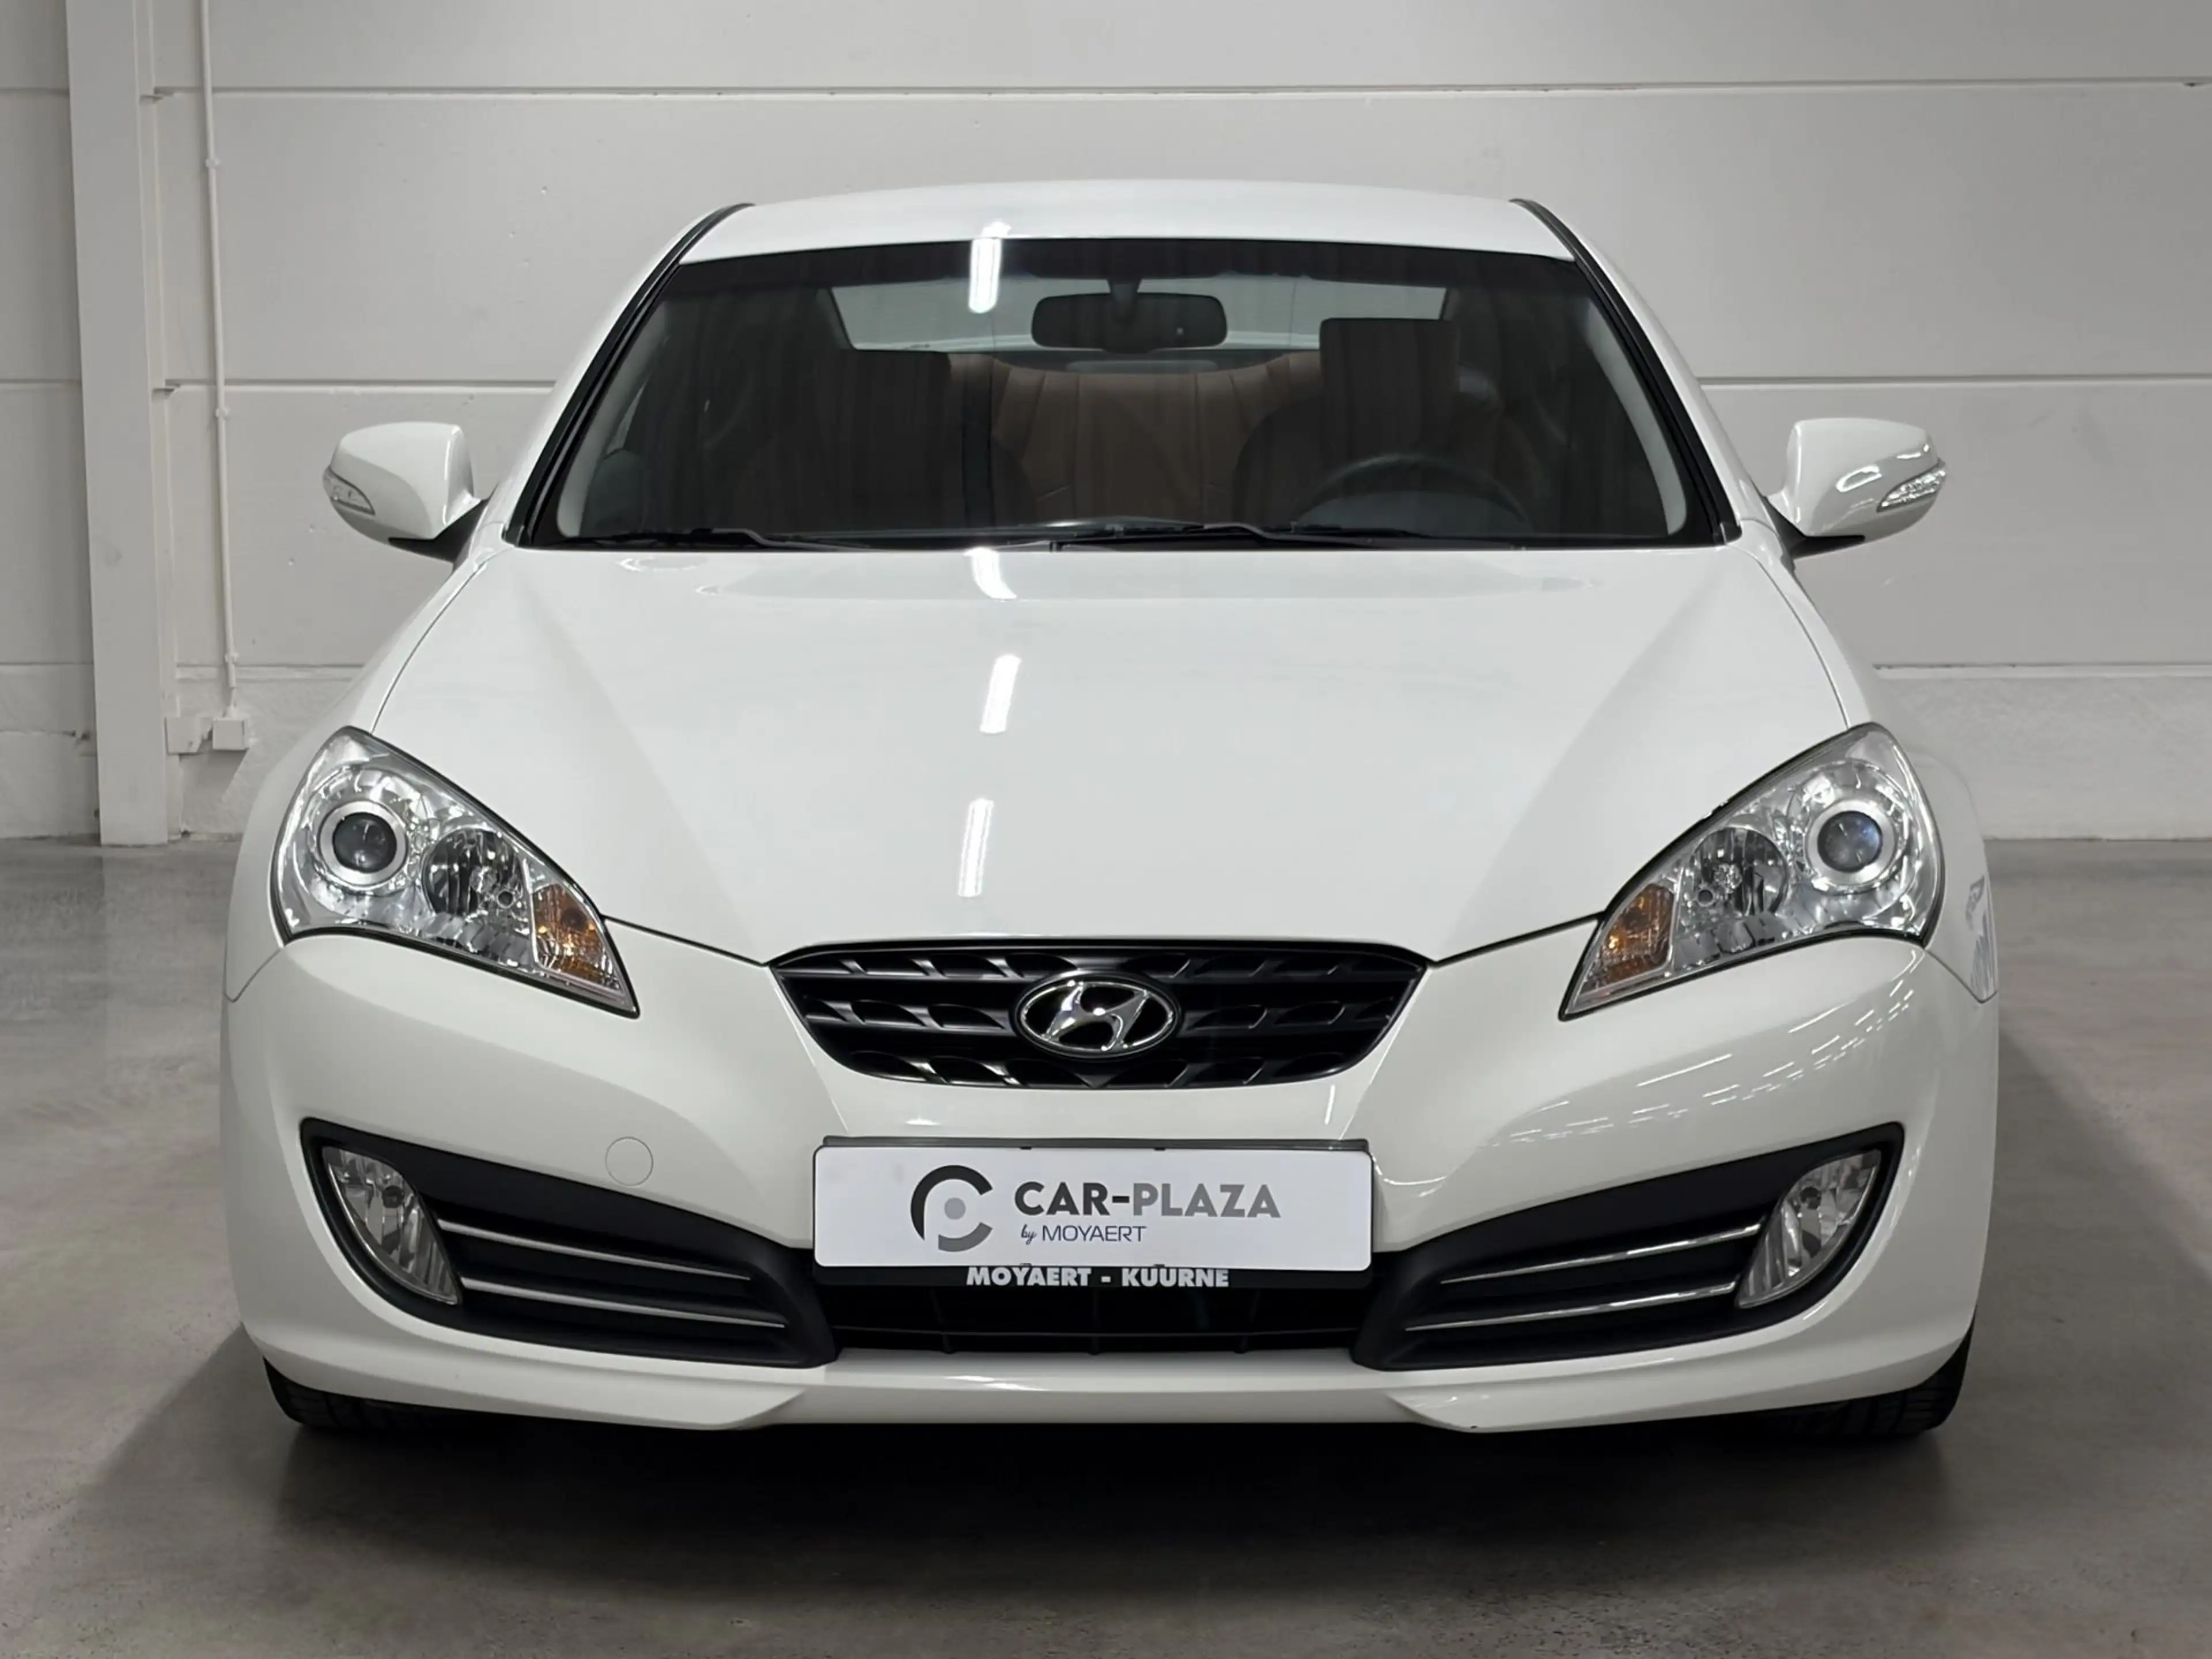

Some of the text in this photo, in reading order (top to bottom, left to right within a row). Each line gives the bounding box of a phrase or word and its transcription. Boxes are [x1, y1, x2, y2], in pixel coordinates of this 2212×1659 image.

[1014, 1181, 1281, 1218] CAR-PLAZA
[1020, 1224, 1147, 1245] by MOYAERT
[966, 1266, 1092, 1286] MOYAERT
[1122, 1267, 1229, 1287] KUURNE
